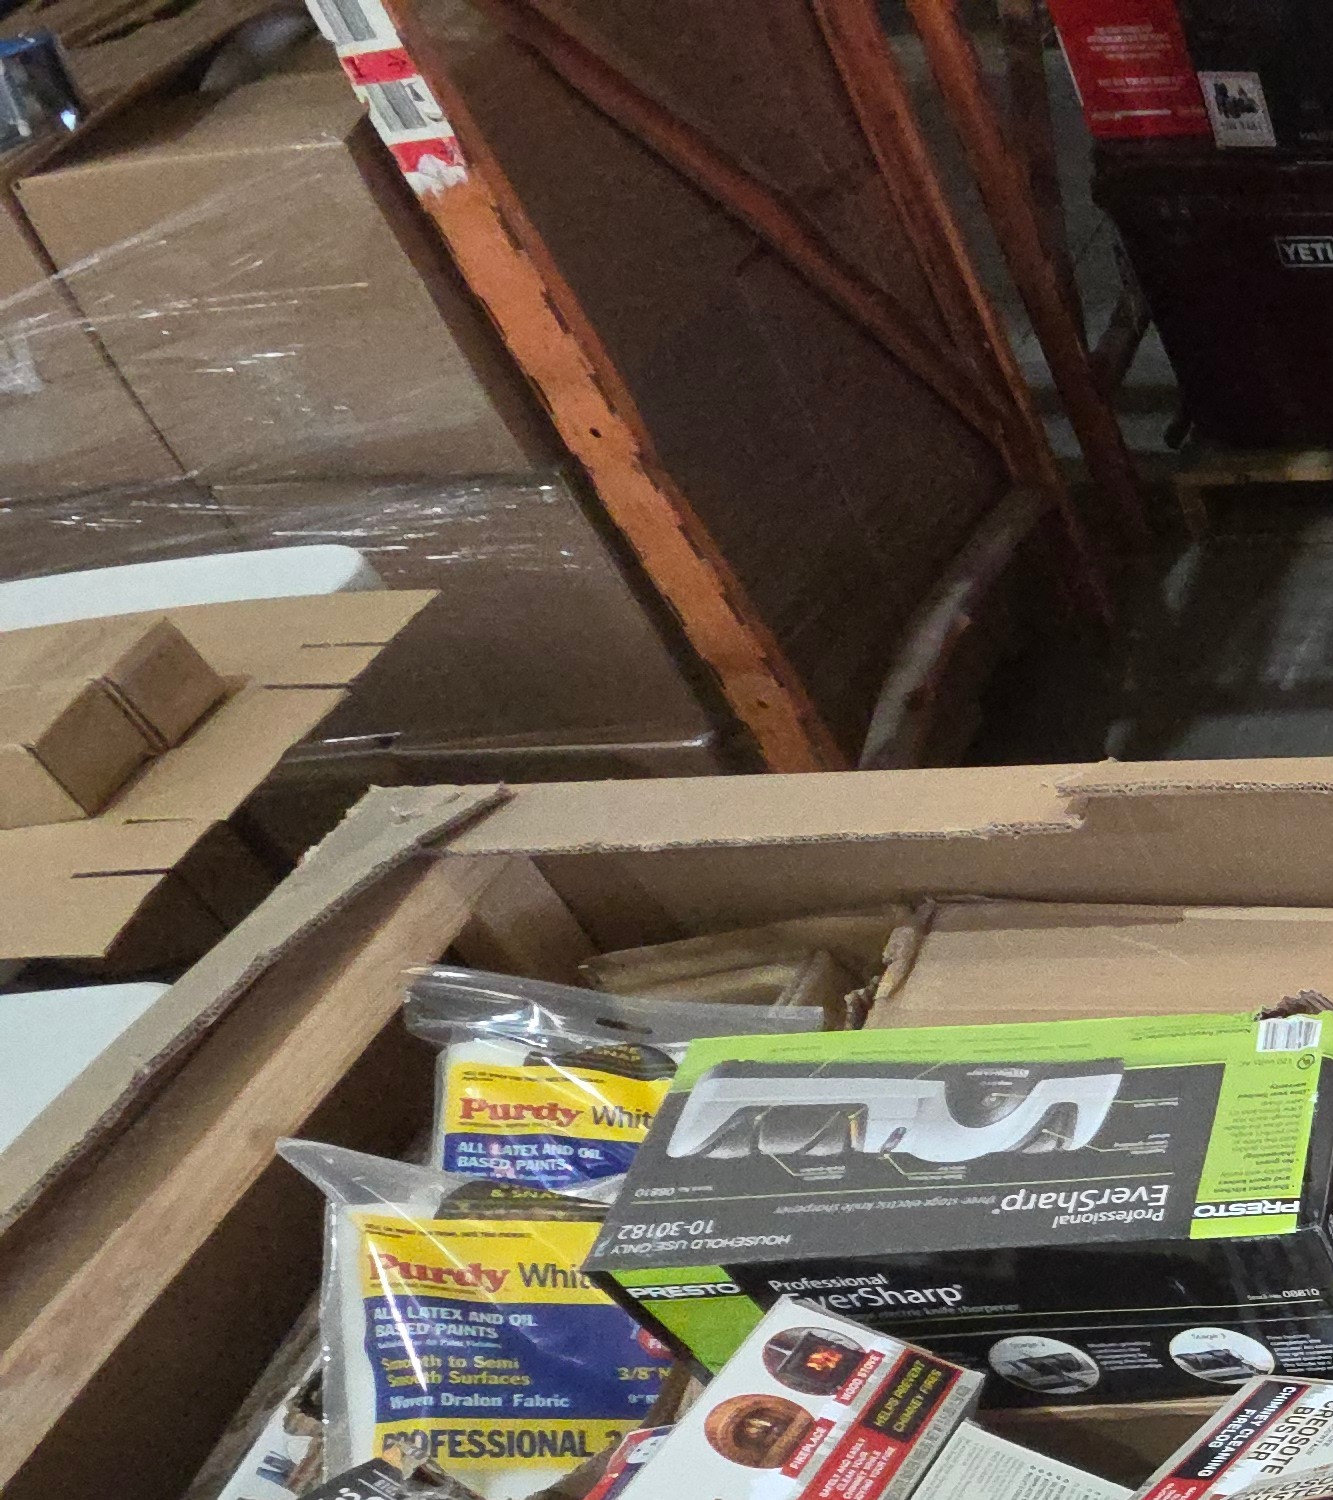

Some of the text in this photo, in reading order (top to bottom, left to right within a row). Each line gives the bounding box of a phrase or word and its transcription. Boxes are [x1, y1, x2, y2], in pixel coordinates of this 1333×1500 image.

[459, 1097, 584, 1128] Purdy
[457, 1142, 574, 1156] ALL LATEX AND
[457, 1157, 510, 1168] BASED
[1001, 1183, 1170, 1214] EverSharp
[1052, 1207, 1165, 1229] Professional
[1192, 1200, 1300, 1219] PRESTO
[618, 1219, 714, 1240] 10-30182
[610, 1234, 791, 1255] HOUSEHOLD USE ONLY
[368, 1253, 511, 1293] Purdy
[625, 1283, 741, 1300] PRESTO
[768, 1274, 888, 1293] Professional
[407, 1306, 503, 1325] LATEX AND
[436, 1324, 499, 1338] PAINTS
[449, 1356, 519, 1369] to Semi
[449, 1371, 531, 1386] Surfaces
[441, 1394, 571, 1409] Dralon Fabric
[1197, 1385, 1297, 1478] CHIMNEY CLEANING
[1208, 1408, 1258, 1449] FIRELOG
[1247, 1405, 1313, 1460] BUSTER
